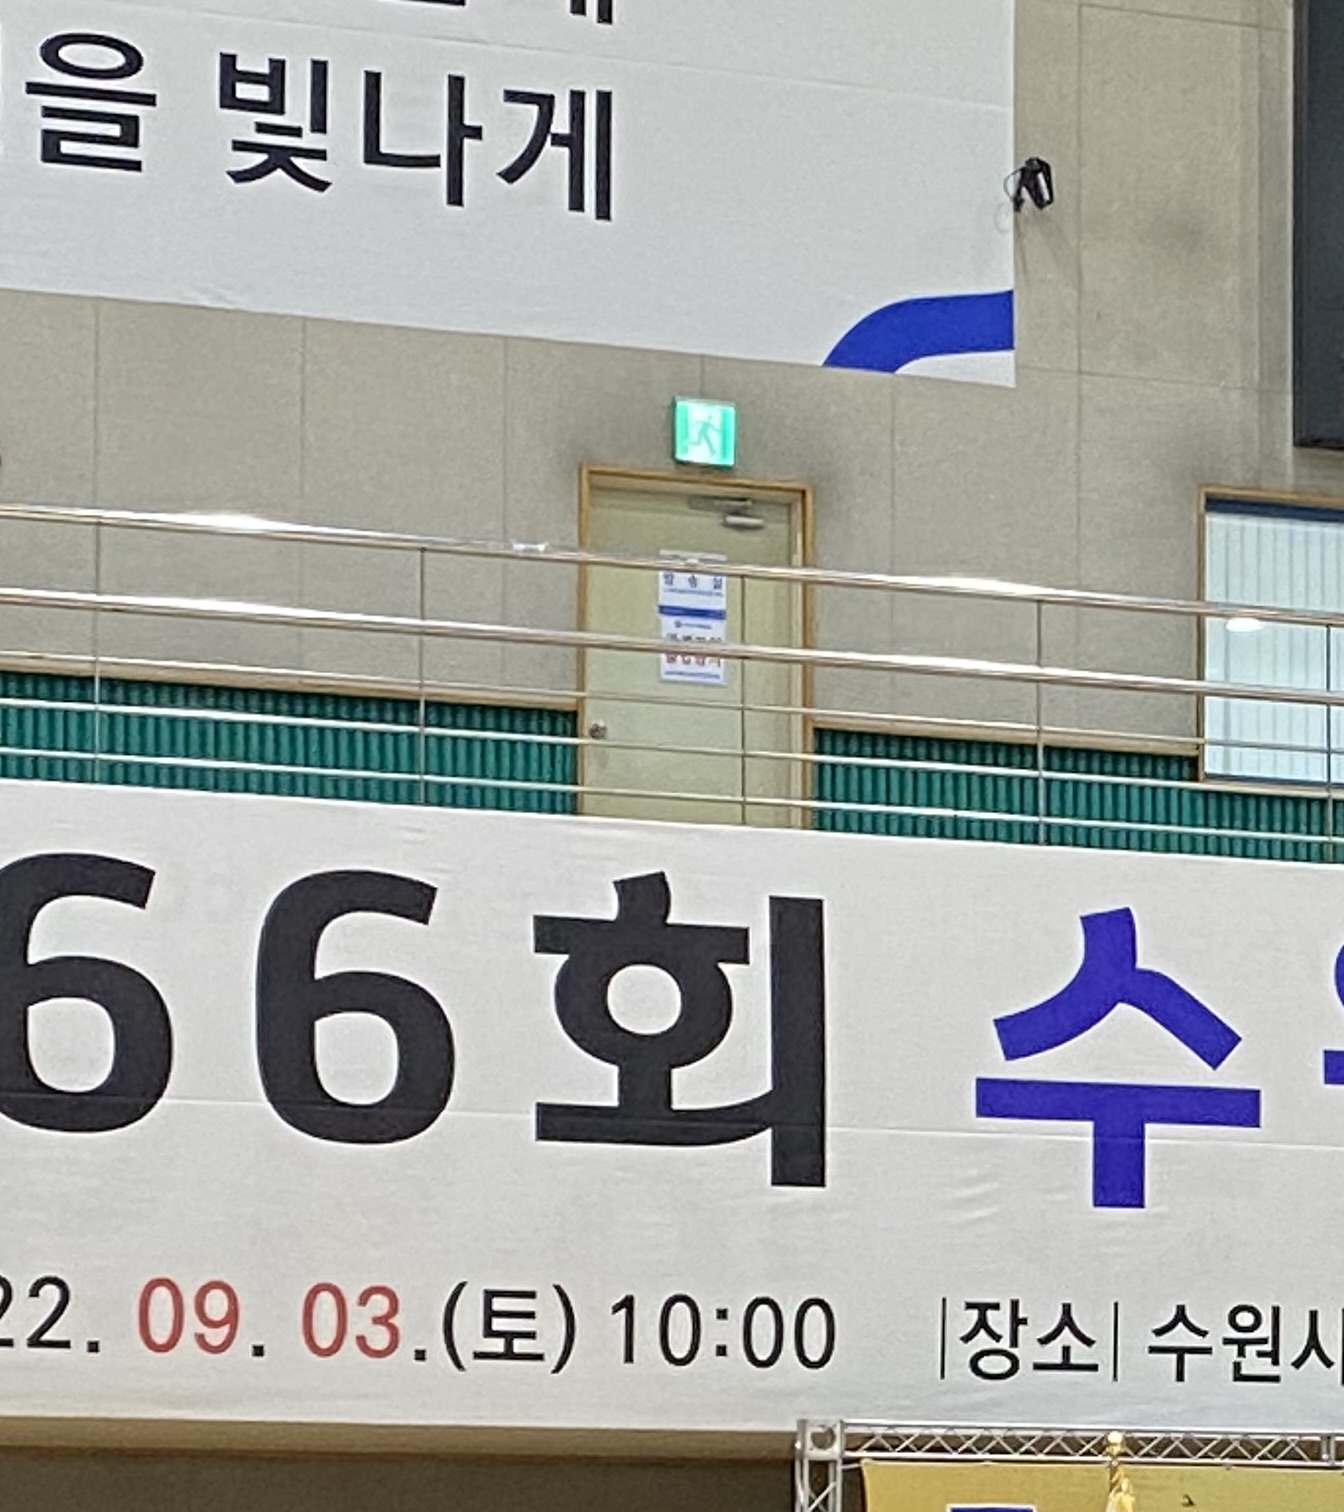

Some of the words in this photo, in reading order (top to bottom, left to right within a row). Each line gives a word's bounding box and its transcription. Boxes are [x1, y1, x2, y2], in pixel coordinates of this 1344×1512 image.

[25, 32, 157, 173] 을
[219, 51, 613, 222] 빛나게
[138, 1277, 265, 1358] 09.
[611, 1294, 836, 1370] 10:00
